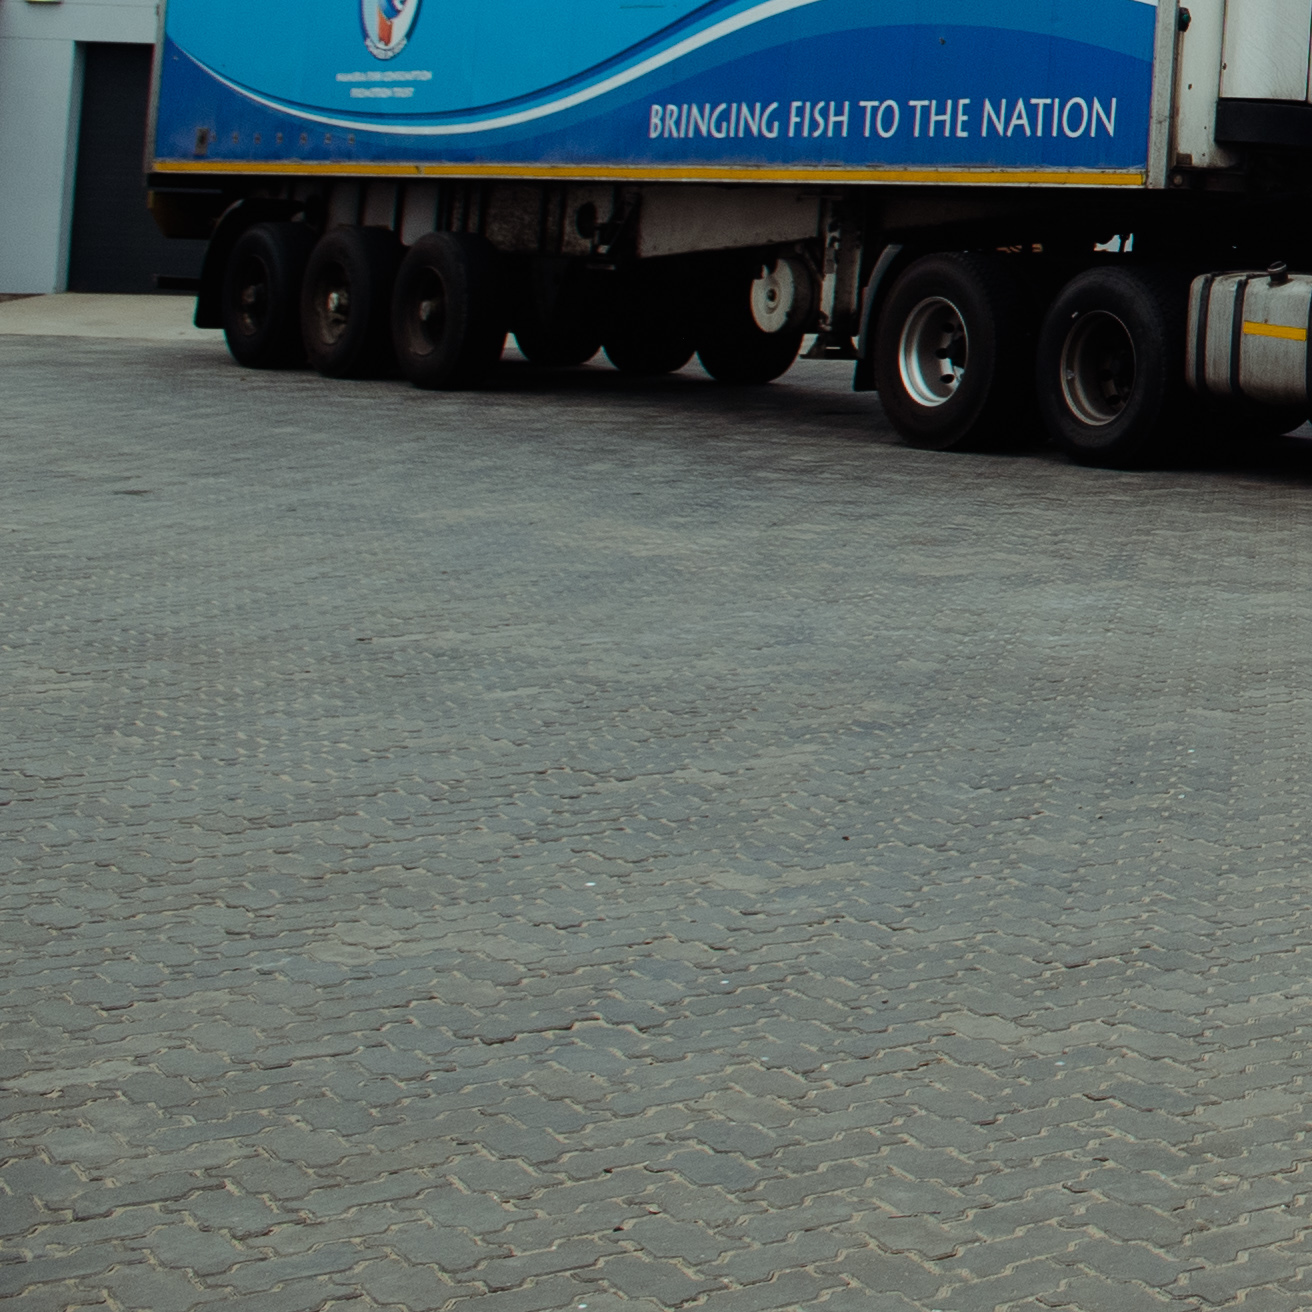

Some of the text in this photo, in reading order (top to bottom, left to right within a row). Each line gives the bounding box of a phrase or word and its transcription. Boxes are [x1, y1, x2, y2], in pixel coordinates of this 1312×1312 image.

[649, 96, 1117, 139] BRINGING FISH TO THE NATION
